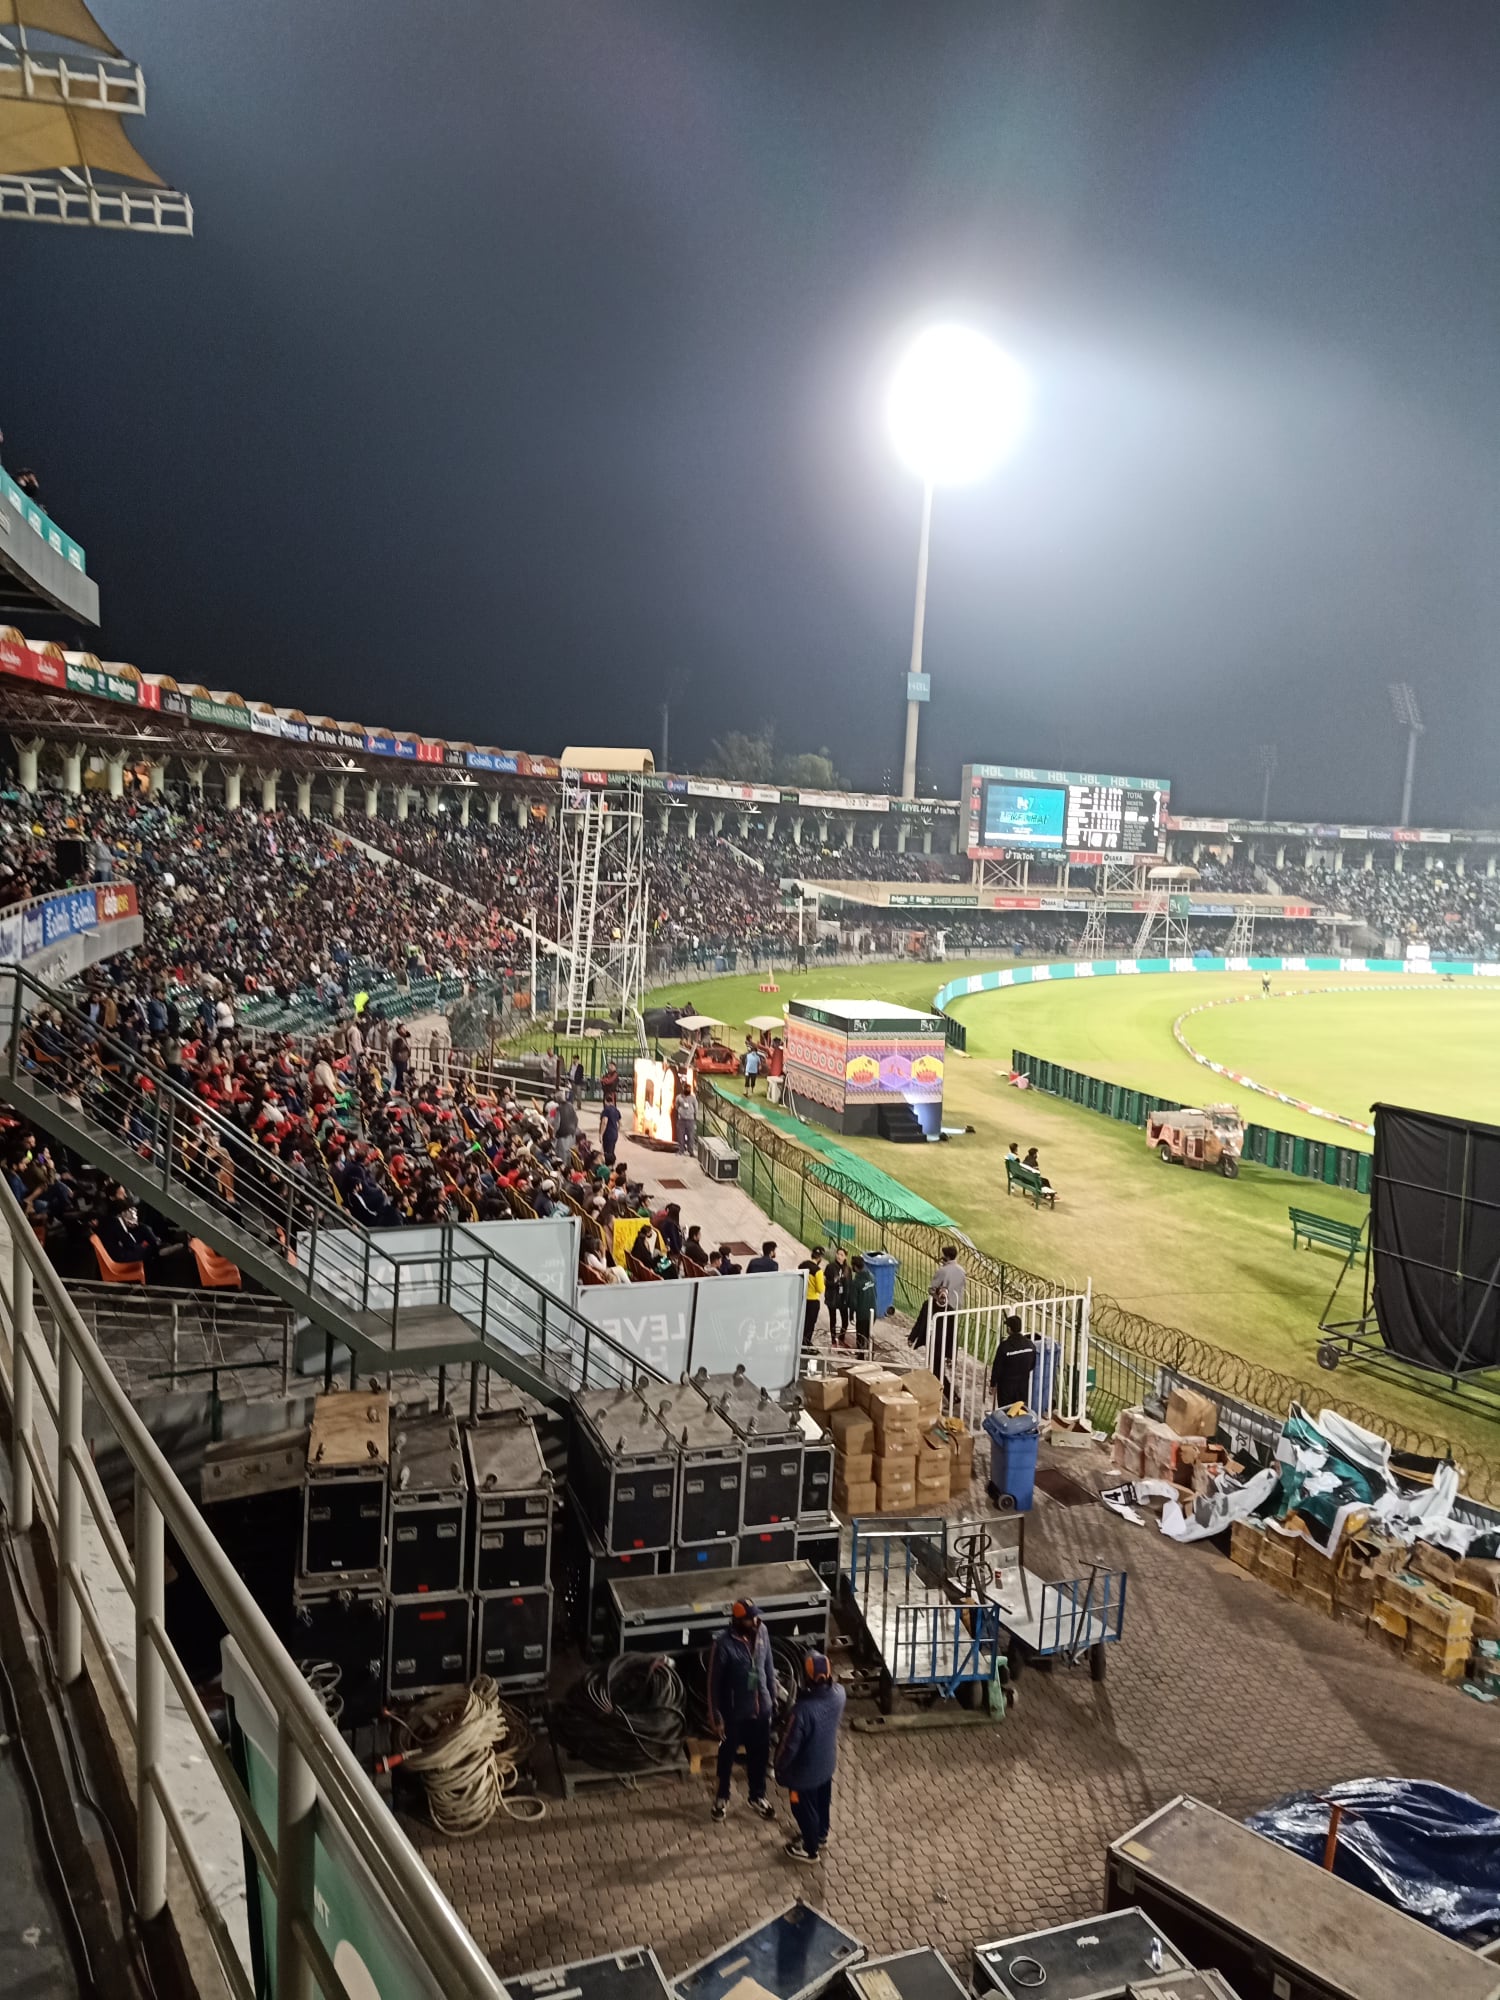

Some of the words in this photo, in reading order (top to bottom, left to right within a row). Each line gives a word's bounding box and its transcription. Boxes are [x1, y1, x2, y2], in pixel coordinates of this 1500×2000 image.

[981, 766, 1004, 777] HBL
[1015, 768, 1038, 780] HBL
[1047, 771, 1070, 783] HBL
[587, 772, 604, 783] TCL
[1079, 774, 1101, 785] HBL
[1110, 776, 1131, 787] HBL
[1140, 778, 1161, 790] HBL
[1127, 791, 1143, 800] TOTAL
[902, 804, 920, 813] LEVEL
[1369, 831, 1392, 840] Haier
[1398, 832, 1417, 841] TCL
[1013, 852, 1035, 861] TikTok
